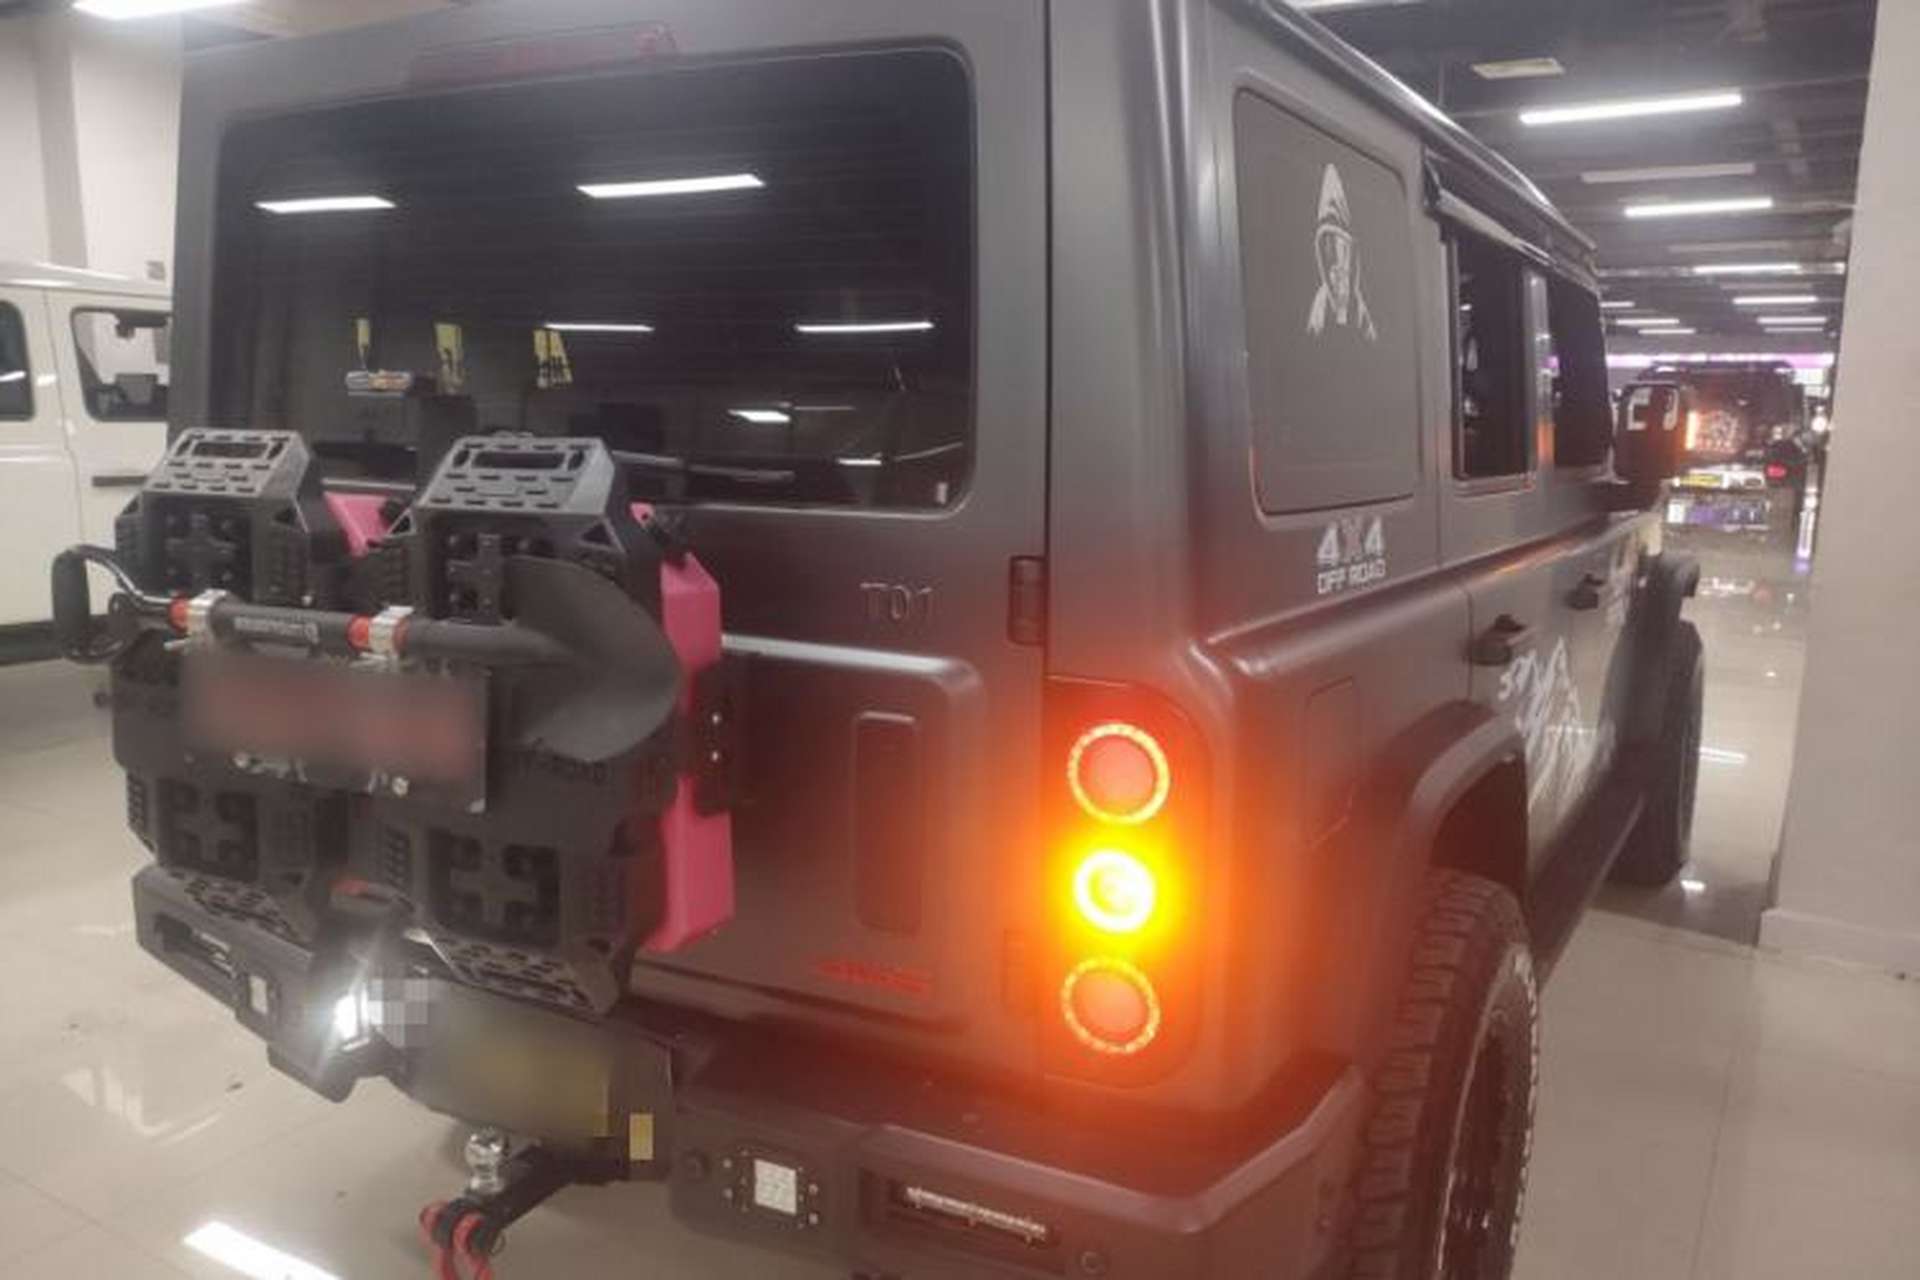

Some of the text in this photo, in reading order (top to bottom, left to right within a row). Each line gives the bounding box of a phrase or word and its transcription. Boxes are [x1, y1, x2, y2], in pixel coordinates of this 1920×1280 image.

[1317, 519, 1384, 566] 4X4
[1317, 559, 1387, 594] OFF ROAD
